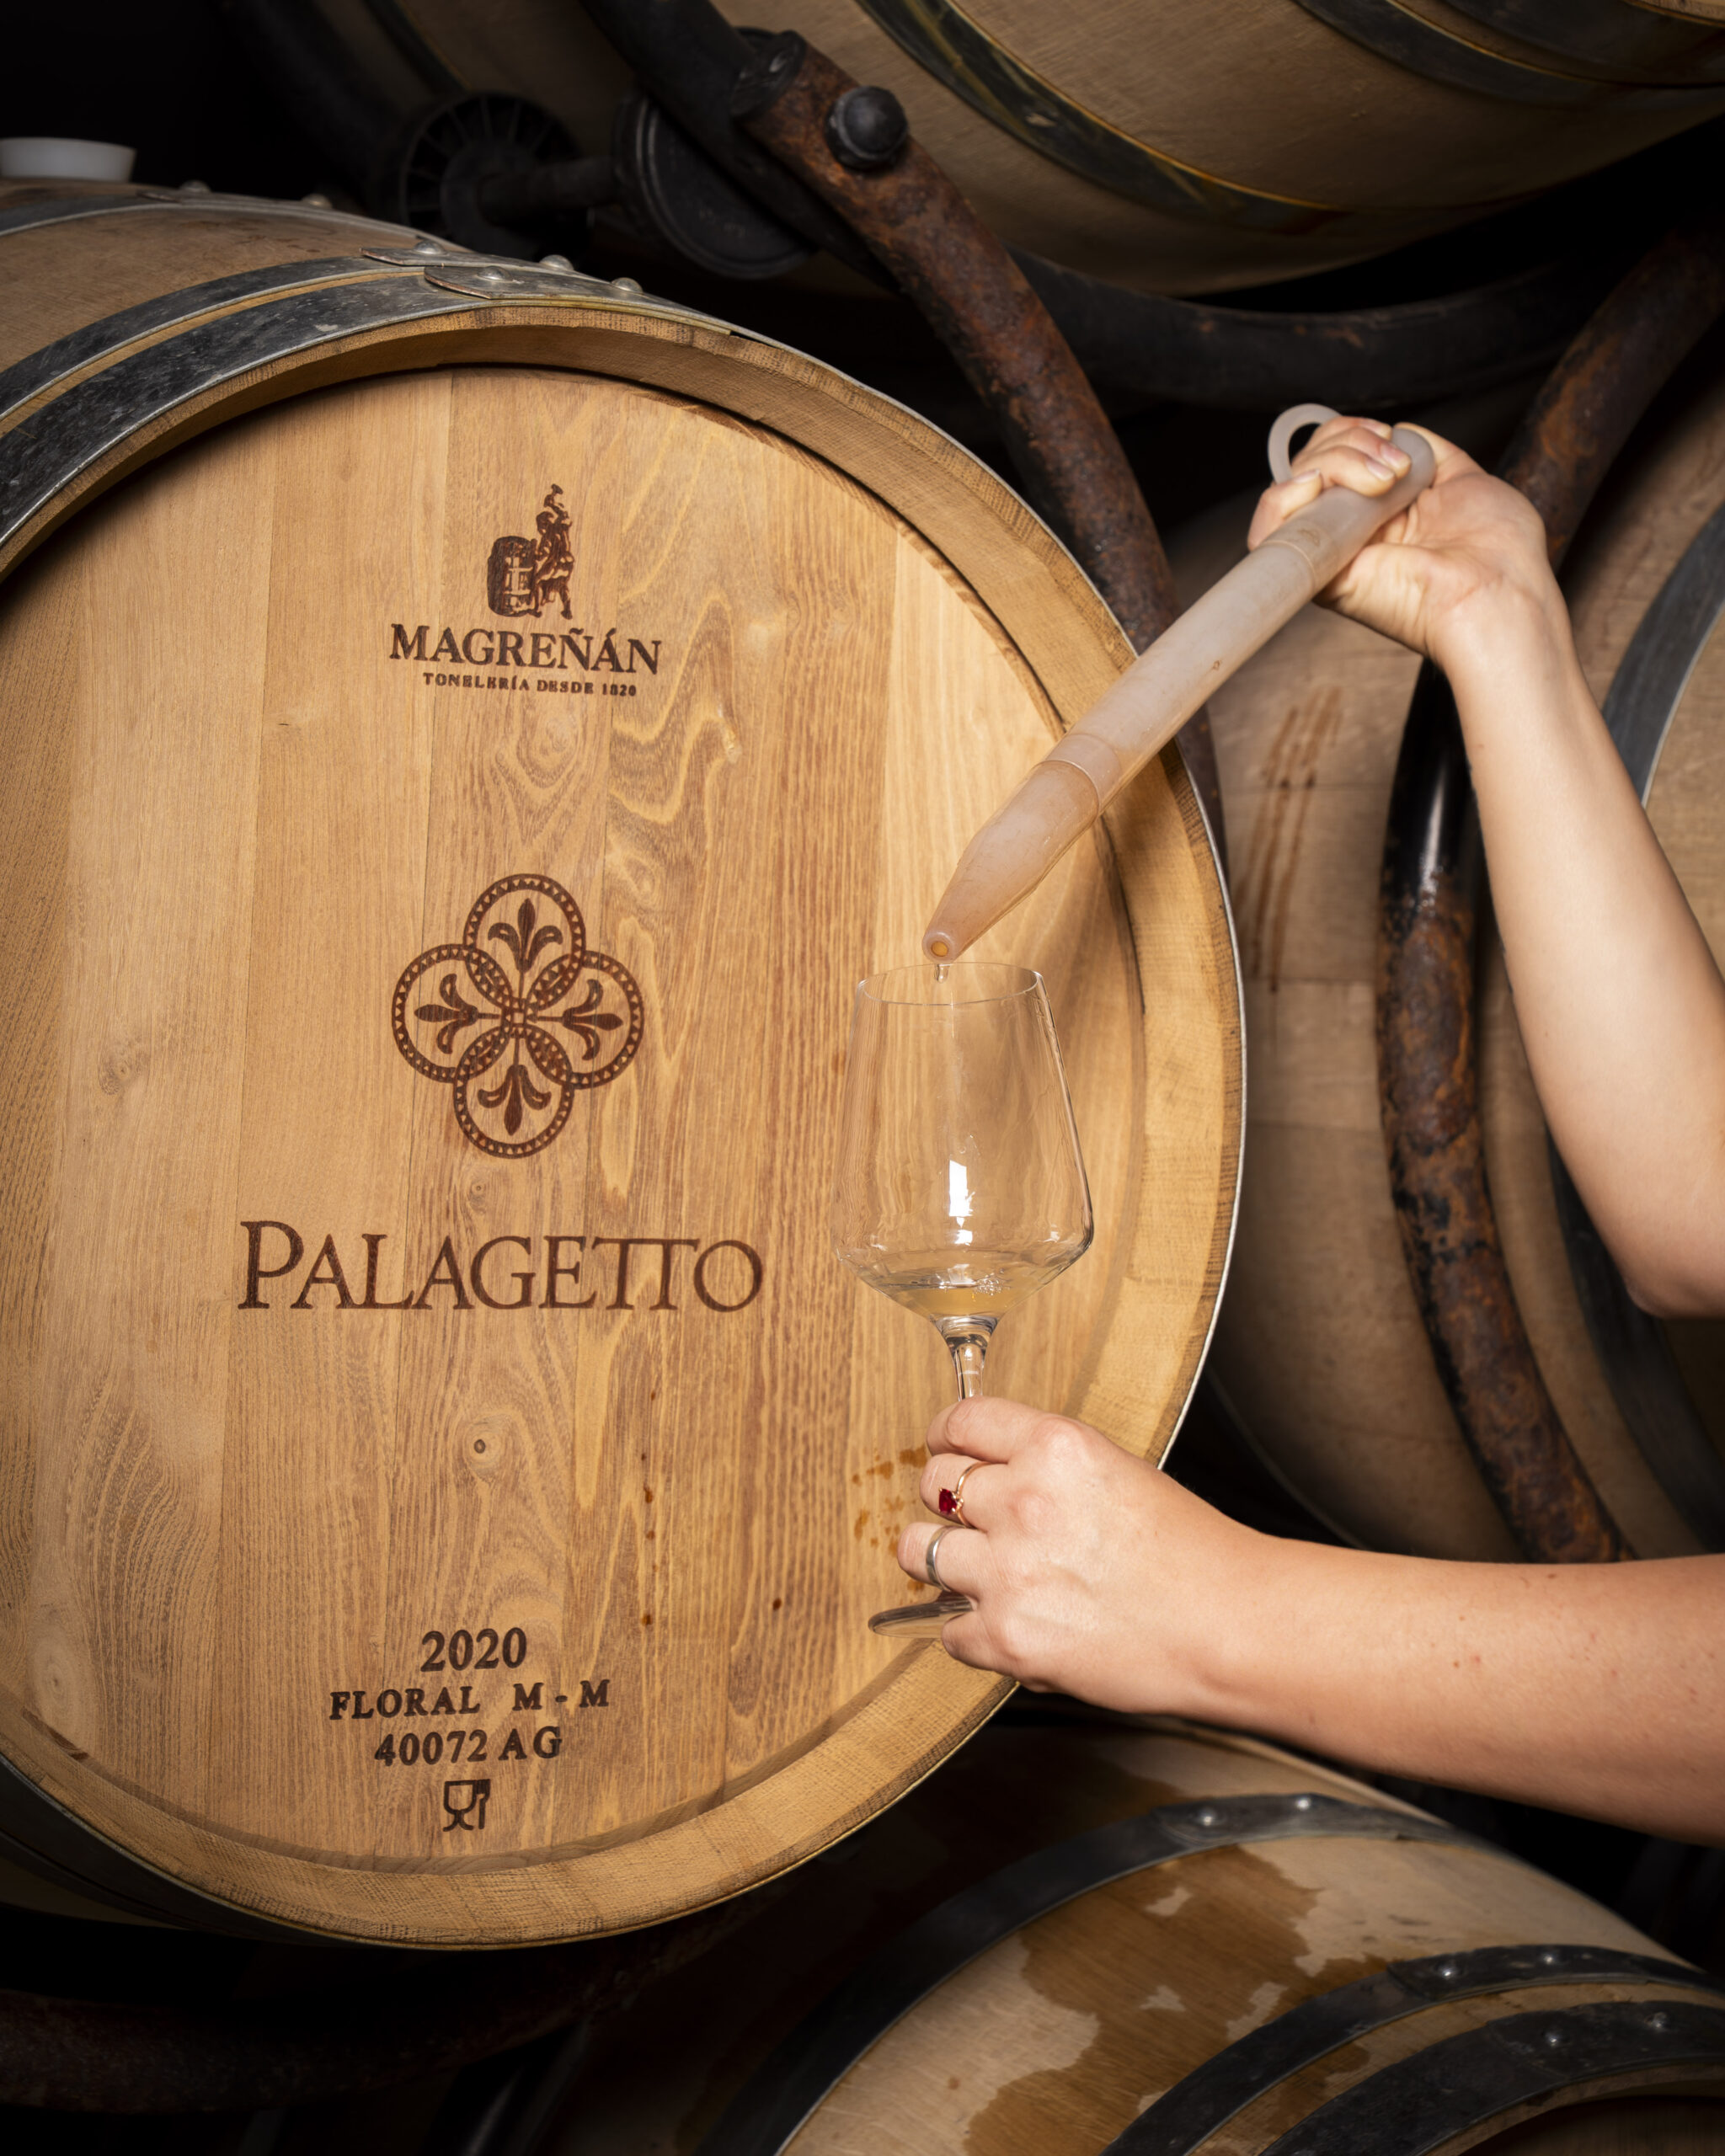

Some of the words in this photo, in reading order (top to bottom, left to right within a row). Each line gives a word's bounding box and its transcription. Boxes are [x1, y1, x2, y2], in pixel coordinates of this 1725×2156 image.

[389, 623, 662, 675] MAGREÑÁN
[537, 679, 595, 695] DESDE
[420, 1627, 527, 1673] 2020
[329, 1685, 481, 1721] FLORAL
[374, 1729, 488, 1767] 40072
[498, 1726, 563, 1761] AG
